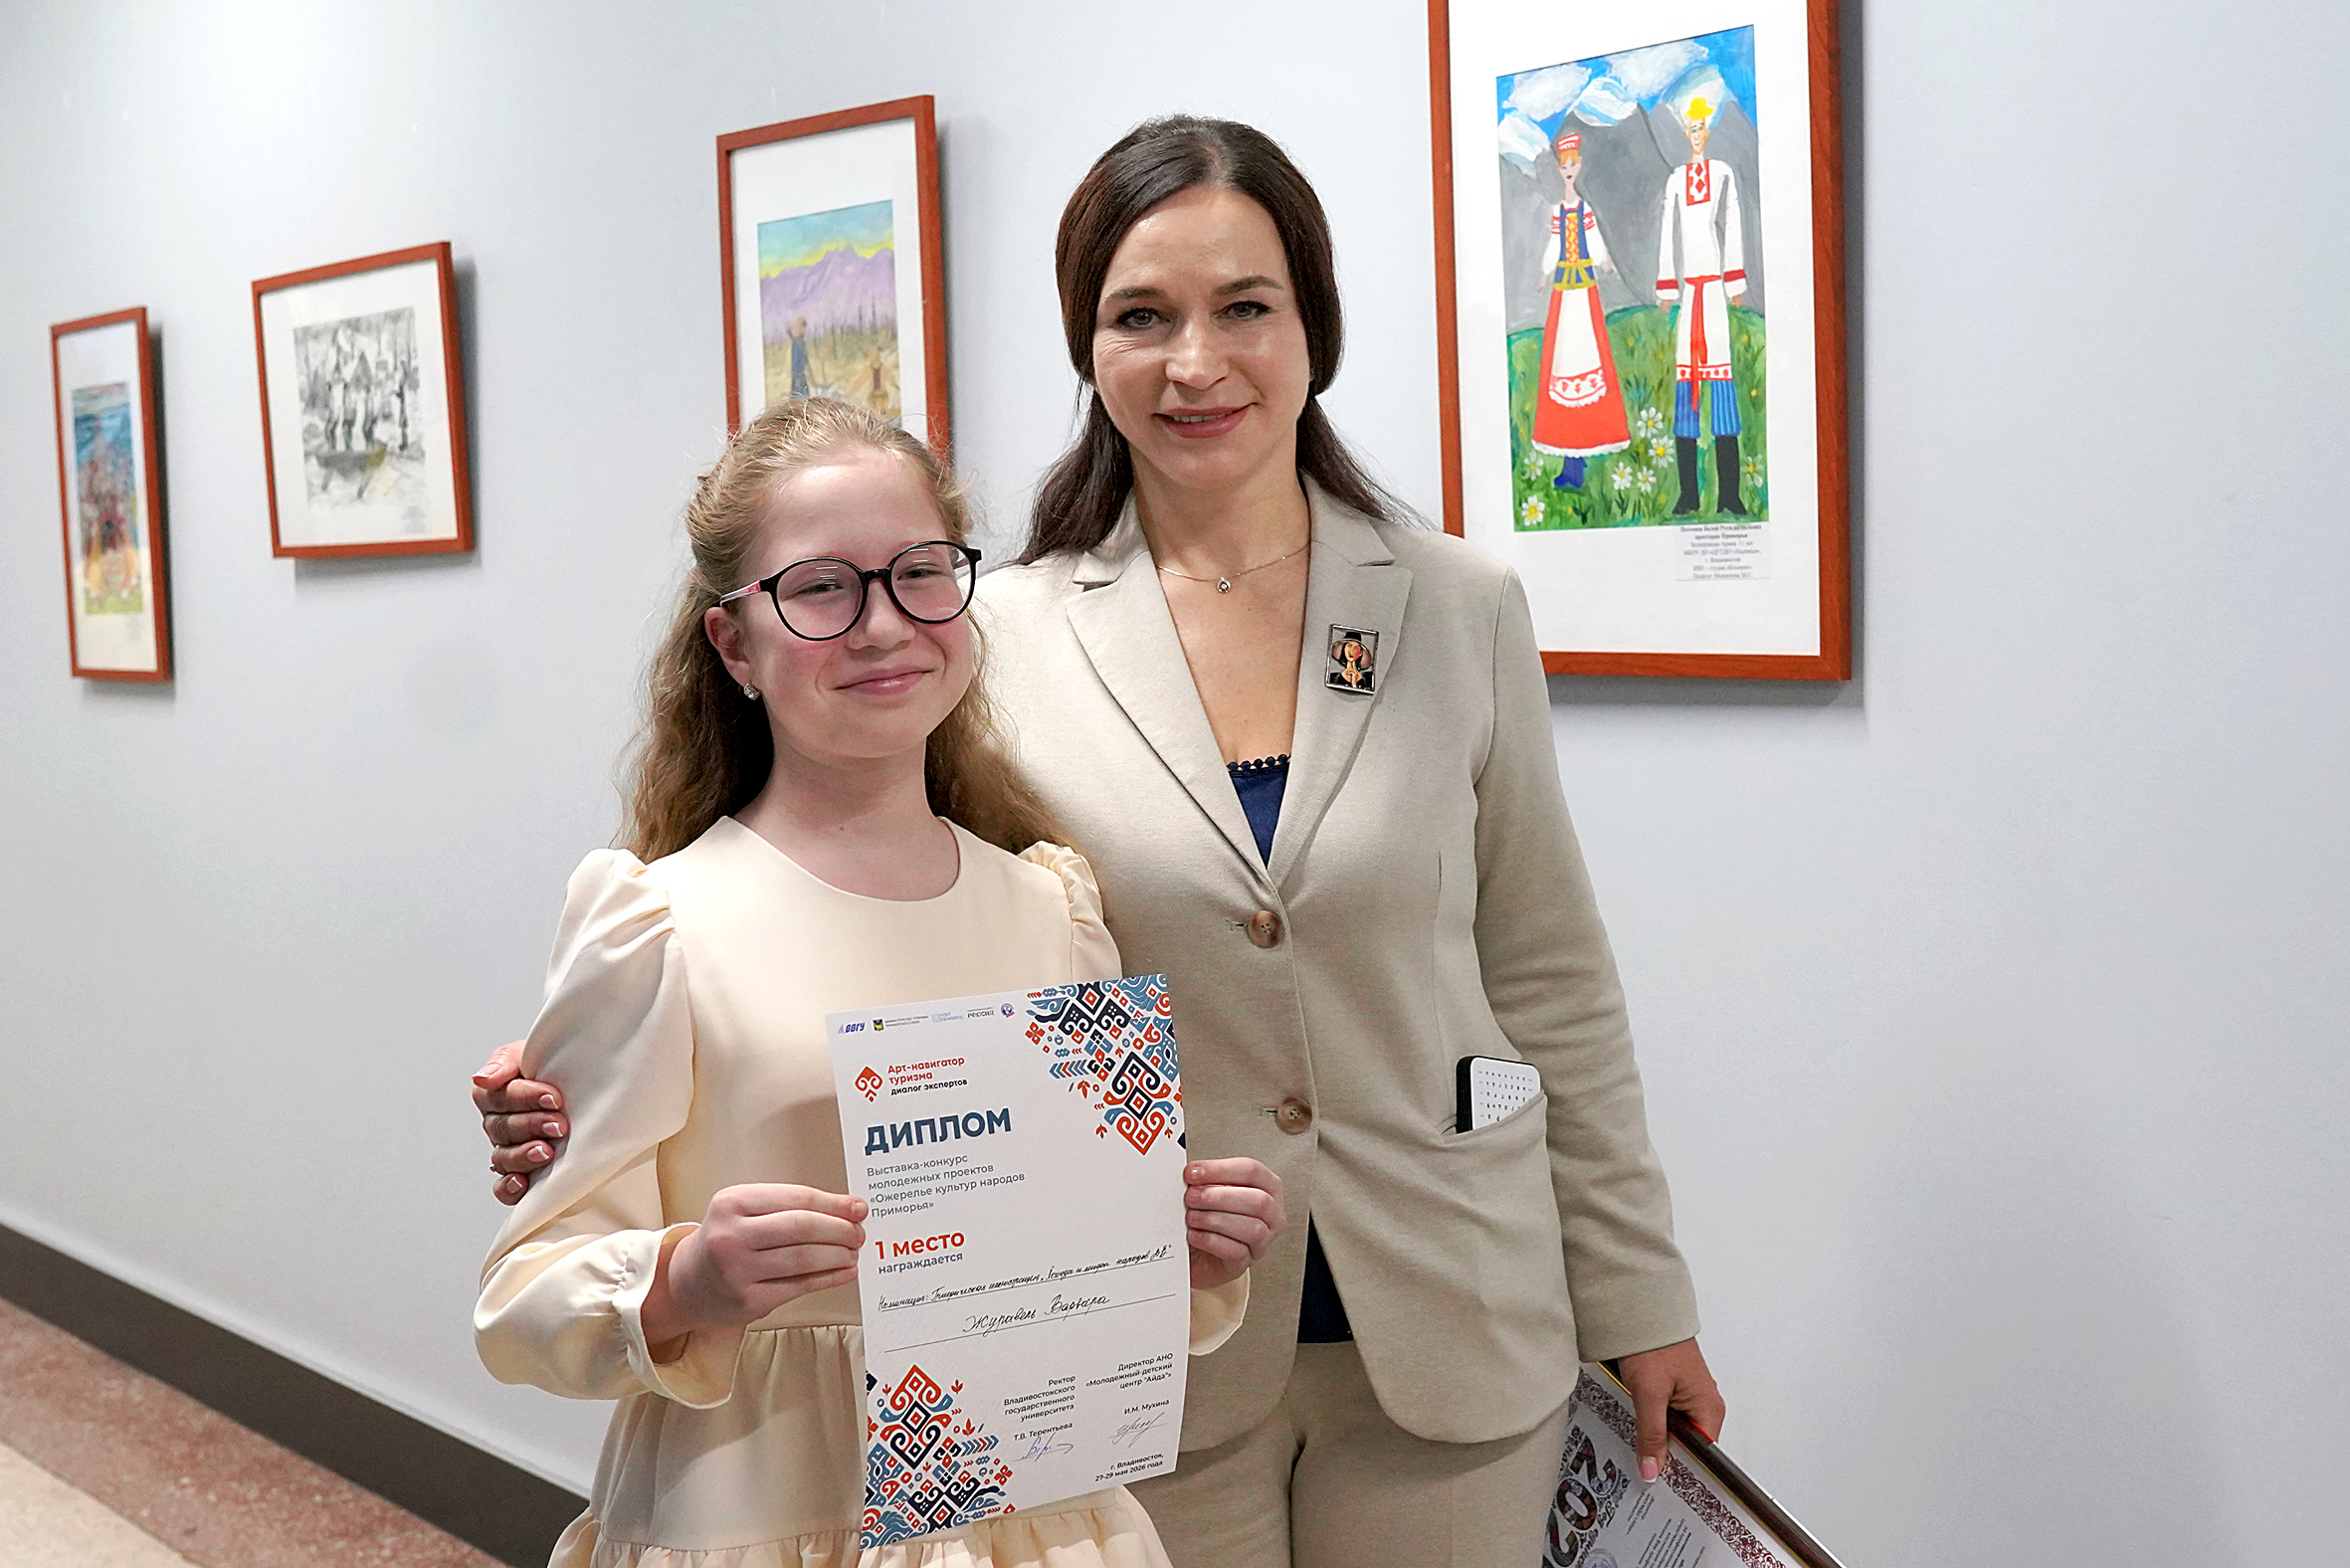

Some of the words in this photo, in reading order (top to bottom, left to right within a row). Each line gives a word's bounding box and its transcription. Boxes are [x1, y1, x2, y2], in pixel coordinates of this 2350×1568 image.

[887, 1057, 965, 1075] Арт-навигатор
[888, 1072, 933, 1086] туризма
[891, 1084, 921, 1096] диалог
[923, 1079, 968, 1090] экспертов
[865, 1107, 1012, 1156] ДИПЛОМ
[867, 1155, 968, 1177] Выставка-конкурс
[869, 1173, 941, 1190] молодежных
[943, 1165, 994, 1180] проектов
[870, 1187, 932, 1203] «Ожерелье
[935, 1181, 977, 1195] культур
[979, 1174, 1025, 1187] народов
[872, 1201, 934, 1218] Приморья»
[875, 1240, 885, 1260] 1
[892, 1232, 965, 1258] место
[879, 1253, 963, 1274] награждается
[1118, 1358, 1155, 1372] Директор
[1156, 1353, 1174, 1363] АНО
[1048, 1375, 1076, 1387] Ректор
[1120, 1379, 1142, 1389] центр
[1004, 1385, 1076, 1406] Владивостокского
[1004, 1394, 1075, 1415] государственного
[1141, 1399, 1170, 1411] Мухина
[1020, 1404, 1074, 1423] университета
[1014, 1433, 1027, 1441] Т.В.
[1029, 1422, 1073, 1438] Терентьева
[1117, 1453, 1164, 1469] Владивосток,
[1095, 1472, 1114, 1482] 27-29
[1129, 1465, 1146, 1473] 2026
